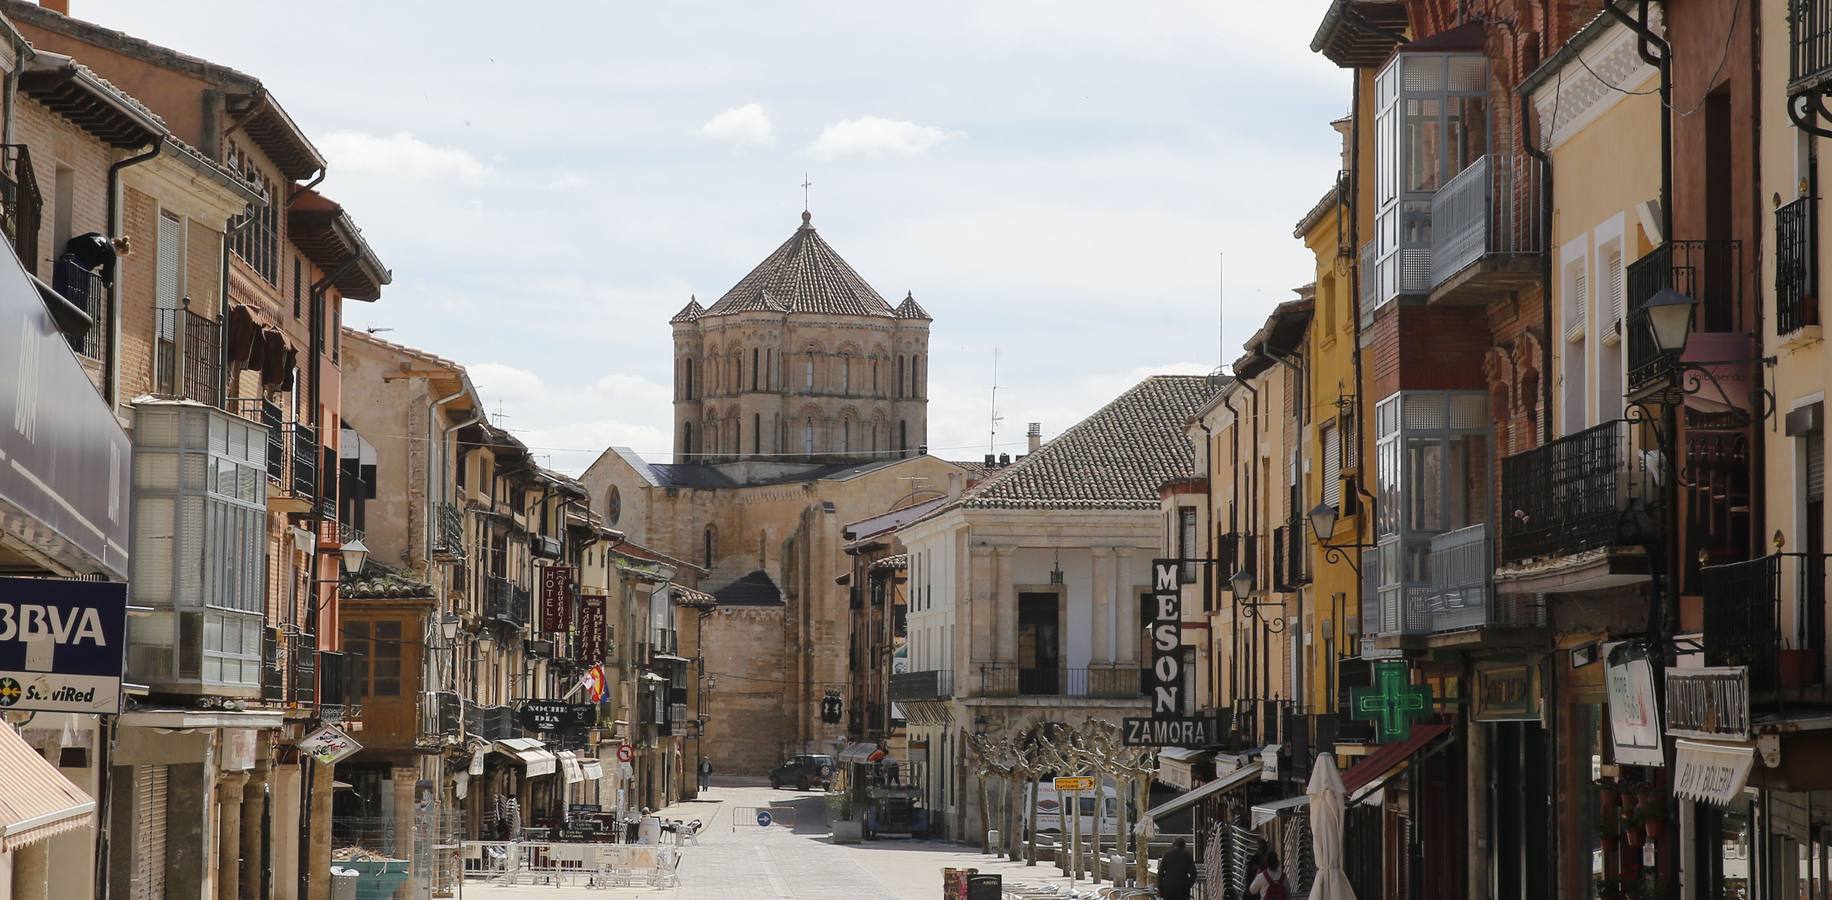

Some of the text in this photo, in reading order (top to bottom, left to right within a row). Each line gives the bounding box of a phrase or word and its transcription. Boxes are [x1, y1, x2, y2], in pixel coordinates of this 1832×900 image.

[546, 571, 555, 616] HOTEL
[0, 603, 106, 646] BBVA
[592, 608, 602, 662] IMPERIAL
[1155, 564, 1178, 713] MESON
[527, 705, 568, 713] NOCHE
[1128, 720, 1206, 744] ZAMORA
